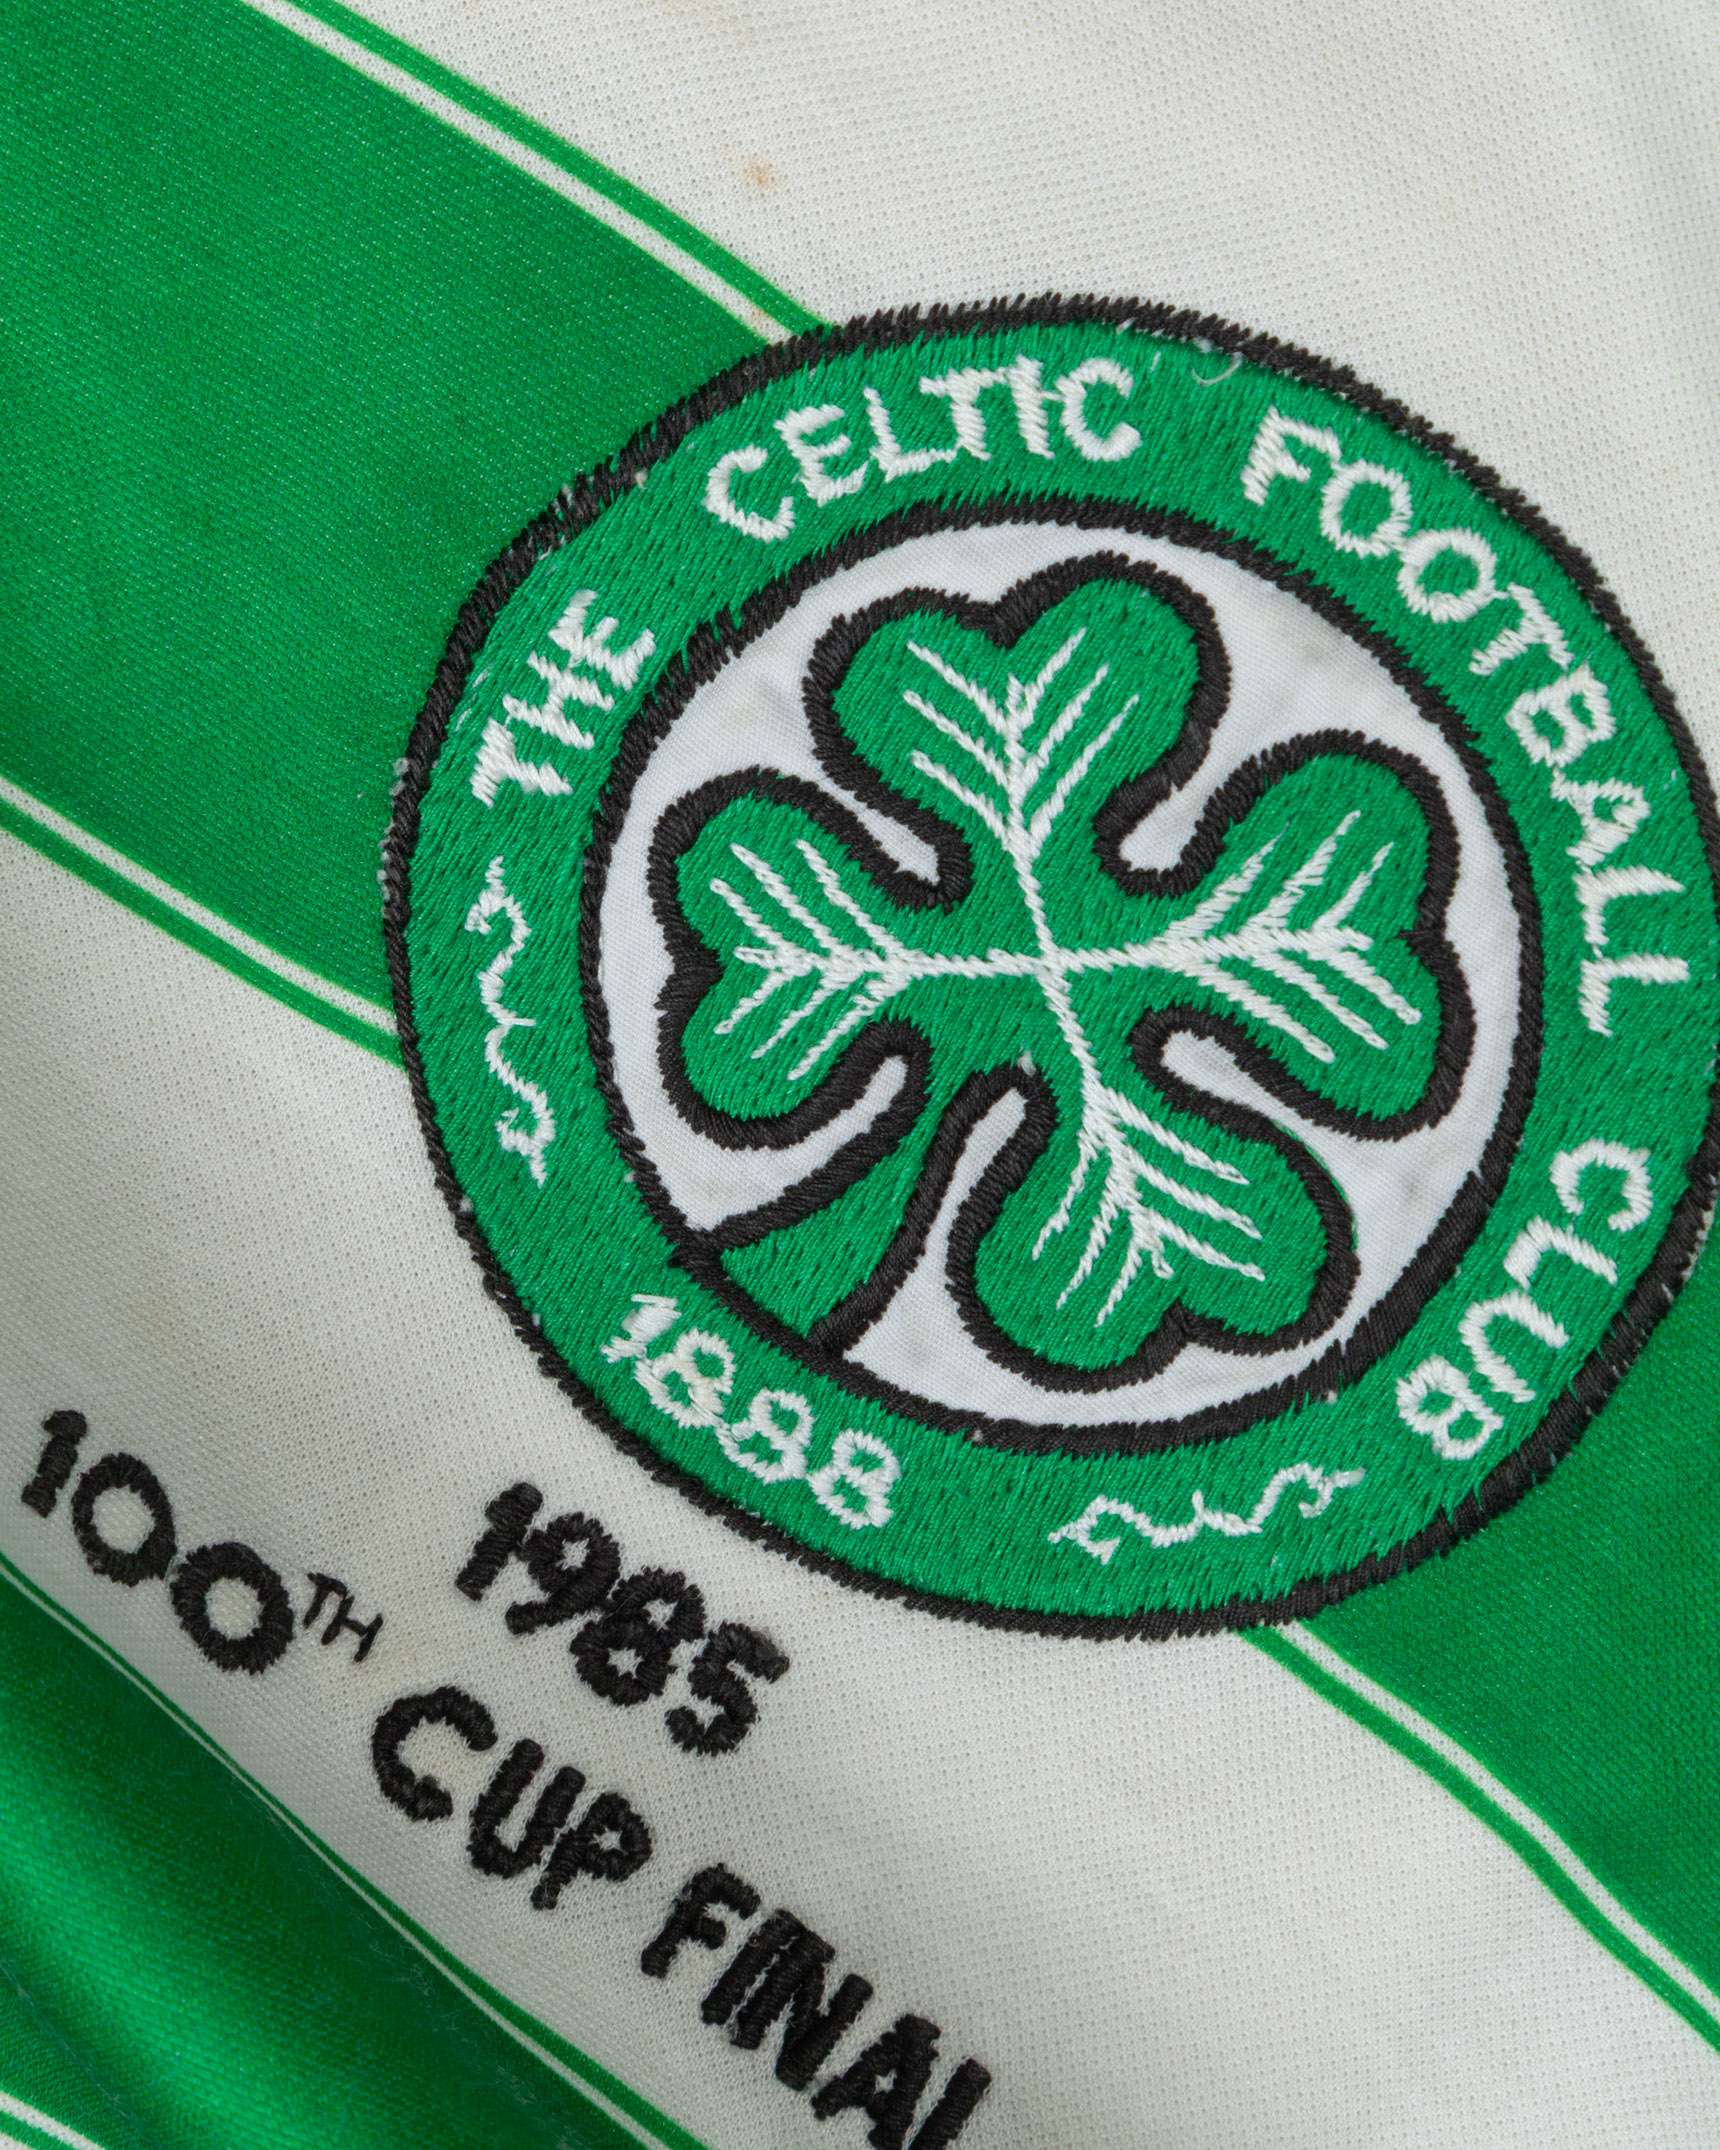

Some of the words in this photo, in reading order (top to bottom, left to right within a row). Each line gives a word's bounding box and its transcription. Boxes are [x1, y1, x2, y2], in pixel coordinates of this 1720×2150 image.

[702, 354, 1142, 544] CELTIC
[469, 589, 657, 806] THE
[1240, 405, 1690, 1037] FOOTBALL
[602, 1294, 900, 1530] 1888
[1396, 1138, 1654, 1461] CLUB
[456, 1481, 790, 1757] 1985
[371, 1685, 654, 1910] CUP
